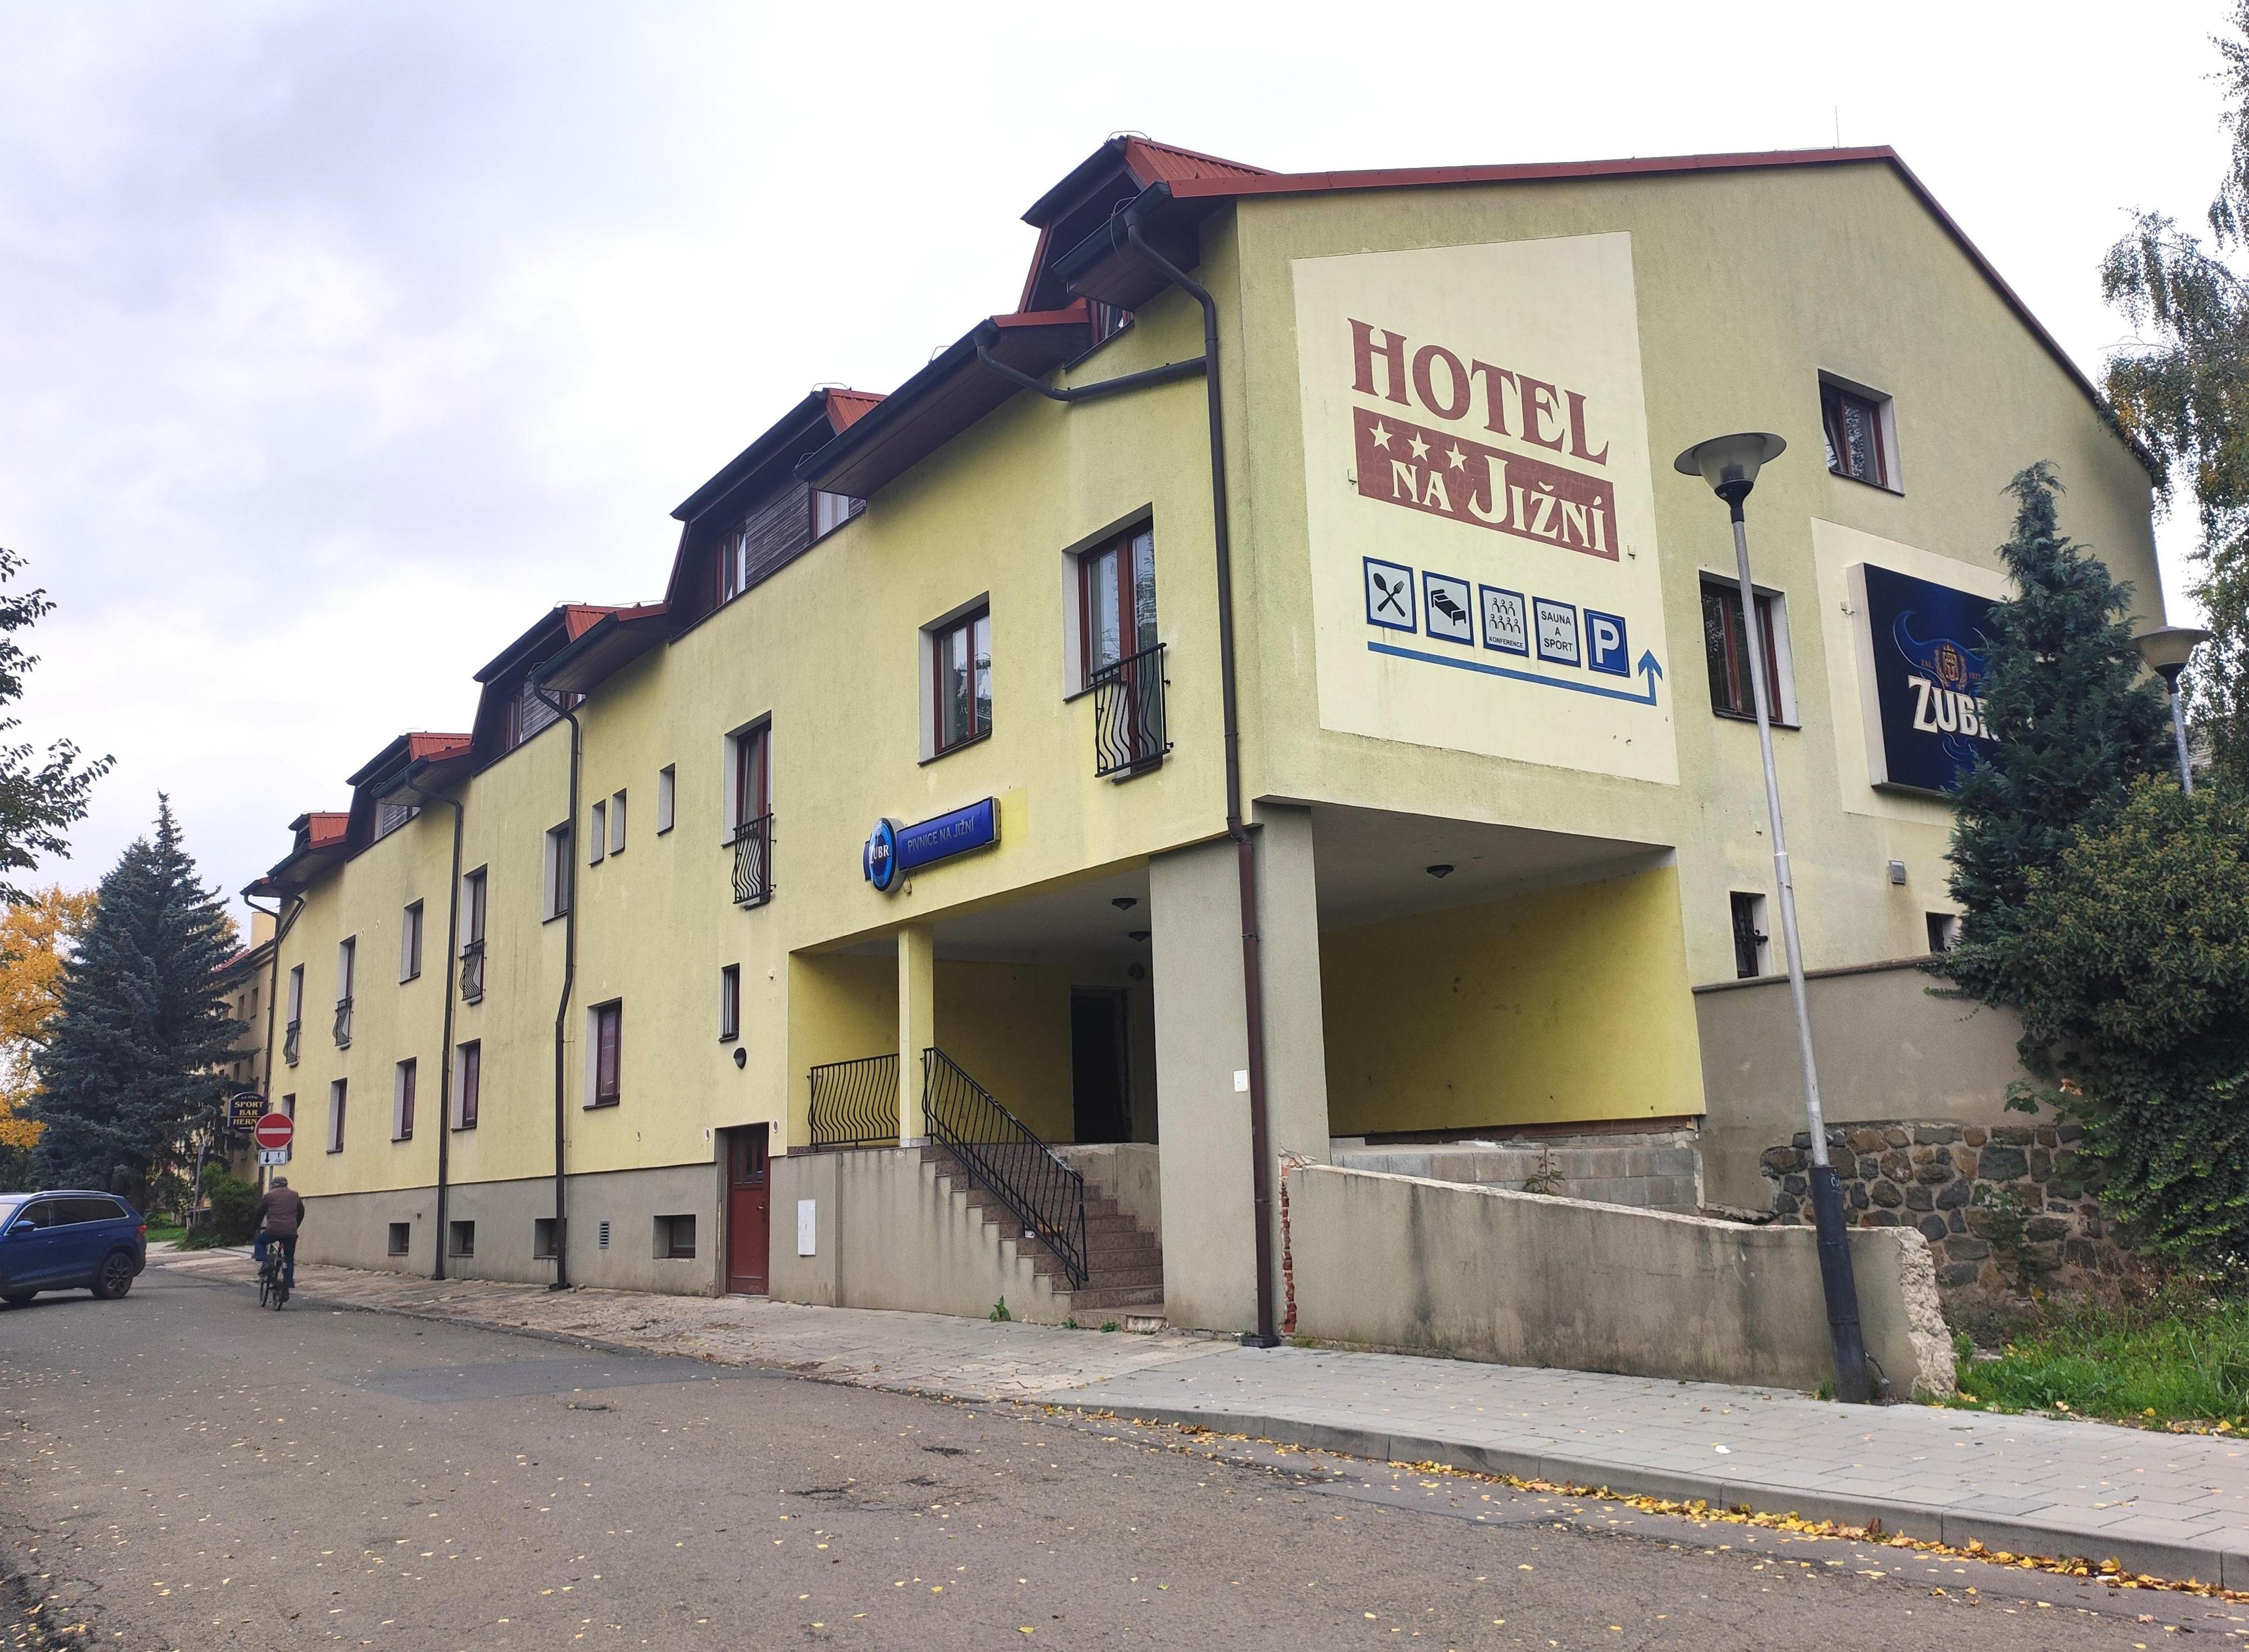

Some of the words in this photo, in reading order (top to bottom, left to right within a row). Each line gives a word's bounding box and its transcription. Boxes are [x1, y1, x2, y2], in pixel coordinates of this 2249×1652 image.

[1347, 318, 1609, 465] HOTEL
[1390, 459, 1454, 512] NA
[1467, 454, 1608, 552] JIŽNÍ
[1541, 610, 1572, 626] SAUNA
[1489, 636, 1523, 648] KONFERENCE
[1555, 627, 1561, 636] A
[1593, 619, 1619, 664] P
[1544, 638, 1573, 652] SPORT
[907, 831, 938, 853] PIVNICE
[940, 827, 952, 842] NA
[954, 815, 974, 838] JIŽNÍ
[870, 844, 889, 865] ZUBR
